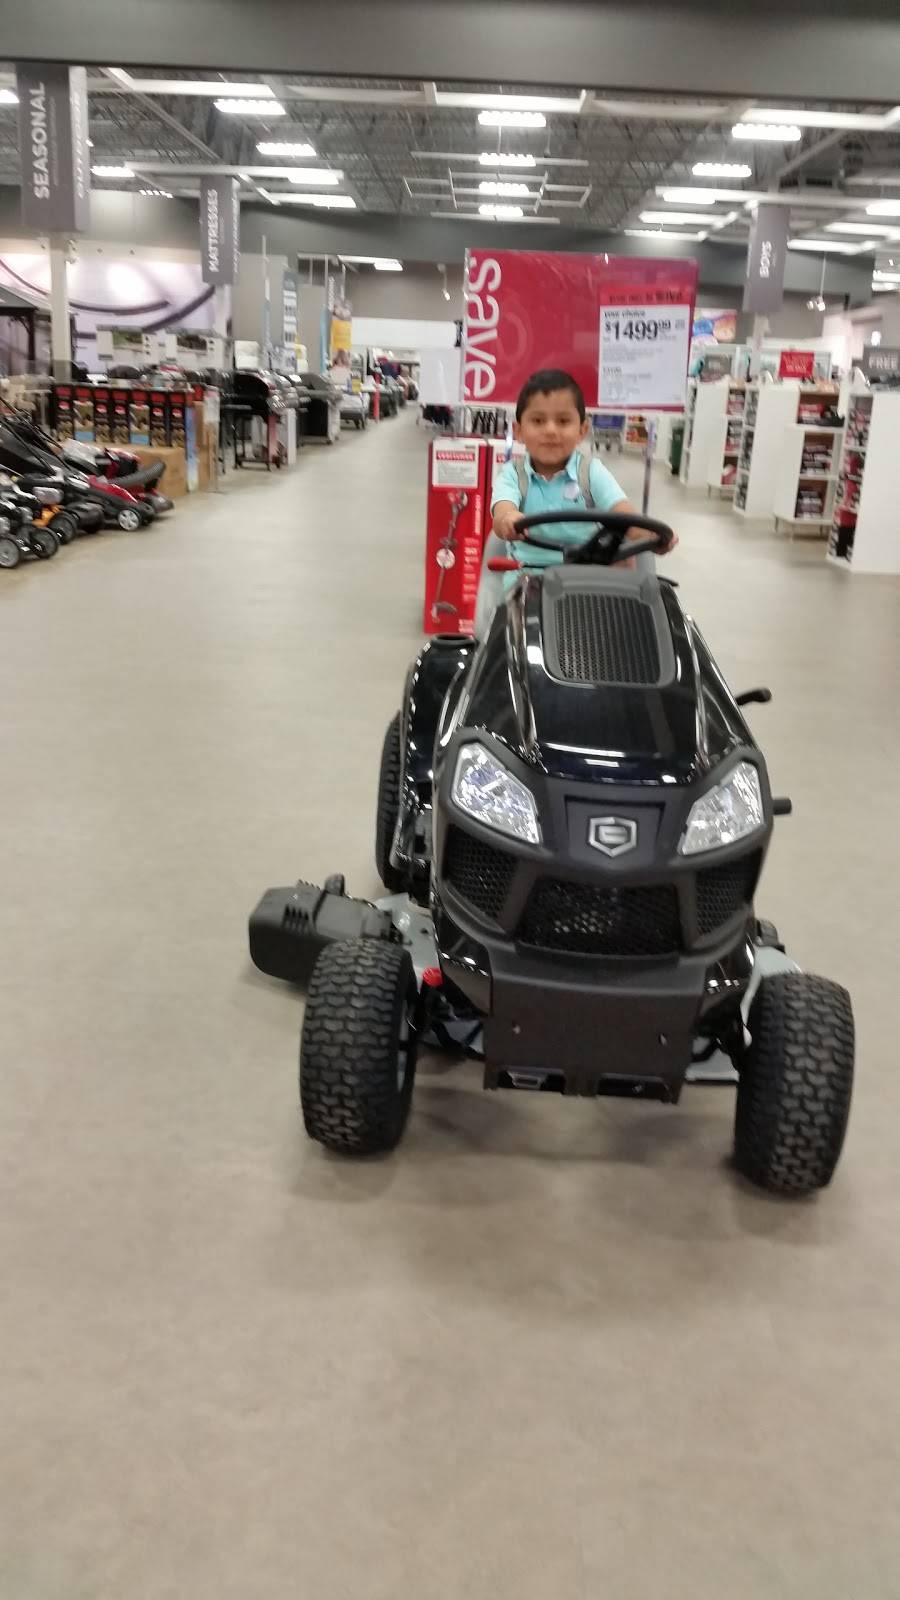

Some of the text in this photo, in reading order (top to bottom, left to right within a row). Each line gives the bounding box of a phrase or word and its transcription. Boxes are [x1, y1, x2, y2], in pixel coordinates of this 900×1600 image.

[29, 82, 50, 200] SEASONAL
[207, 188, 219, 273] MATTRESSES
[759, 240, 772, 279] BOYS
[463, 257, 502, 399] save
[869, 356, 897, 369] FREE
